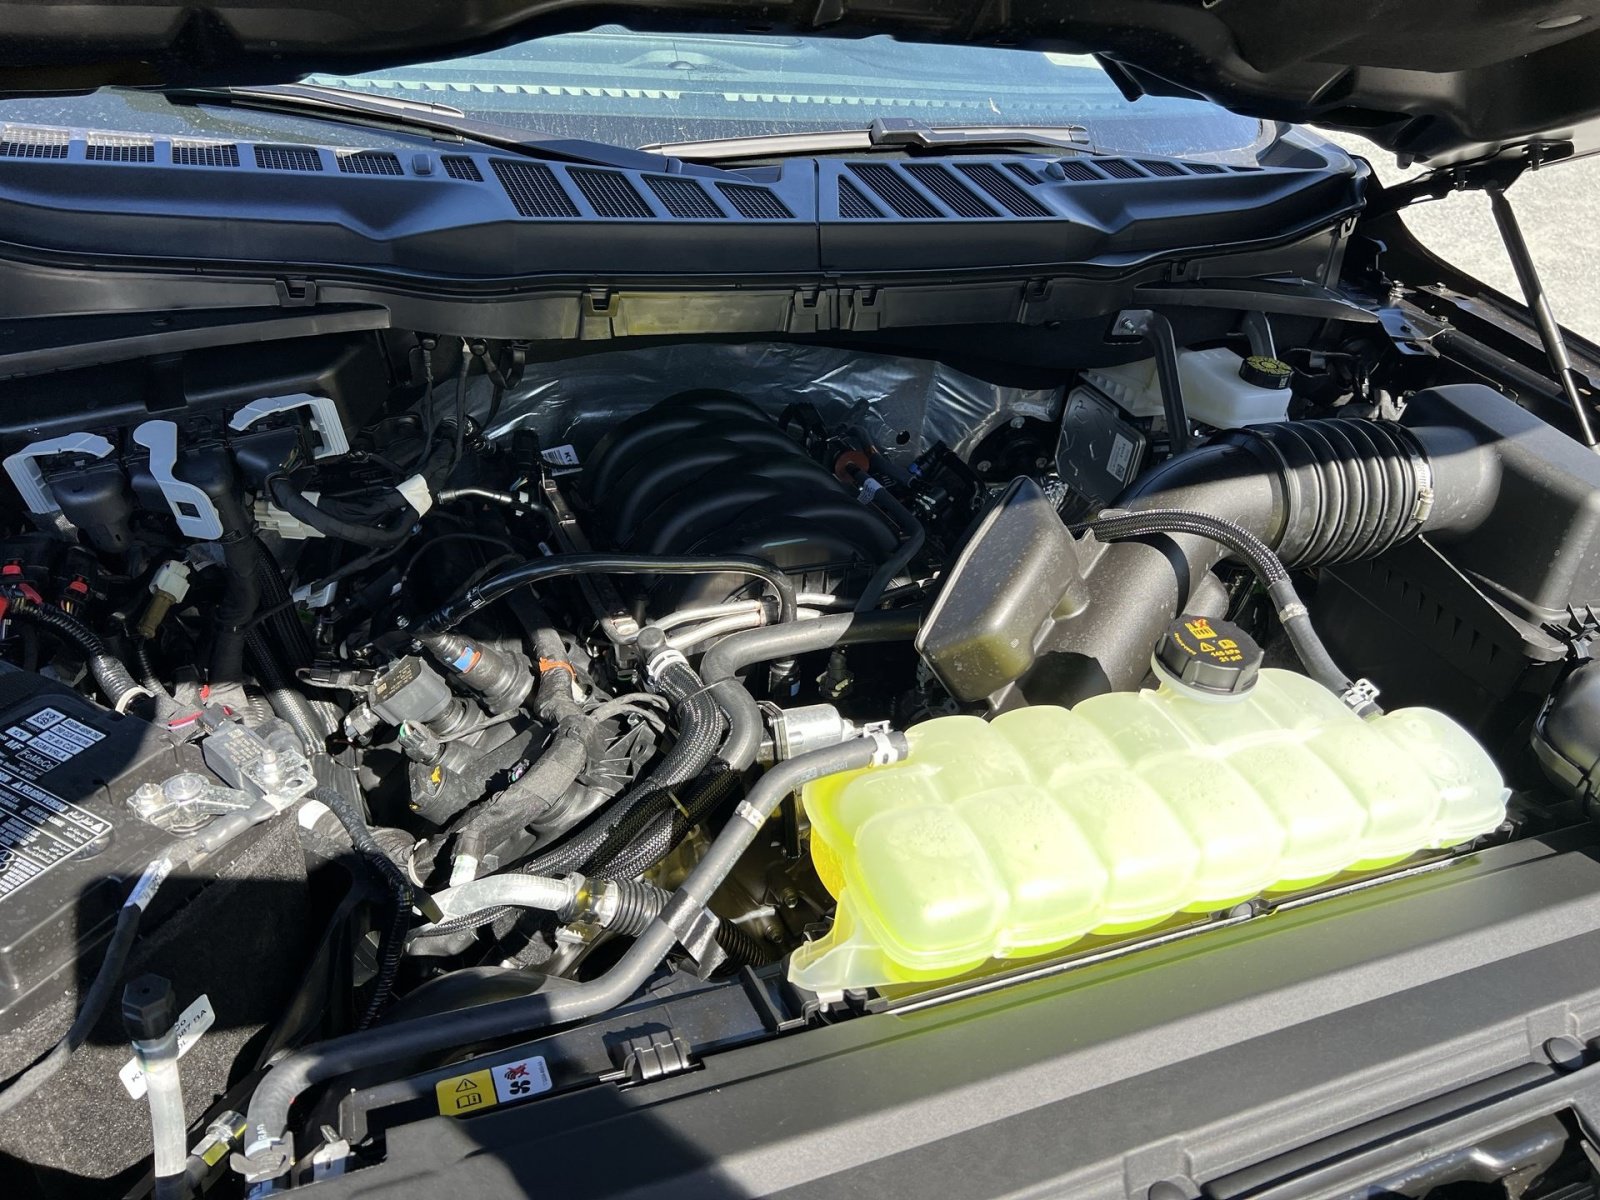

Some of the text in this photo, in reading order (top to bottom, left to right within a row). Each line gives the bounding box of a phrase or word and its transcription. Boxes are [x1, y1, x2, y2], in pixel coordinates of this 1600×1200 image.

[13, 729, 25, 738] 12V
[4, 740, 25, 750] MF
[21, 750, 54, 770] FoMoCo
